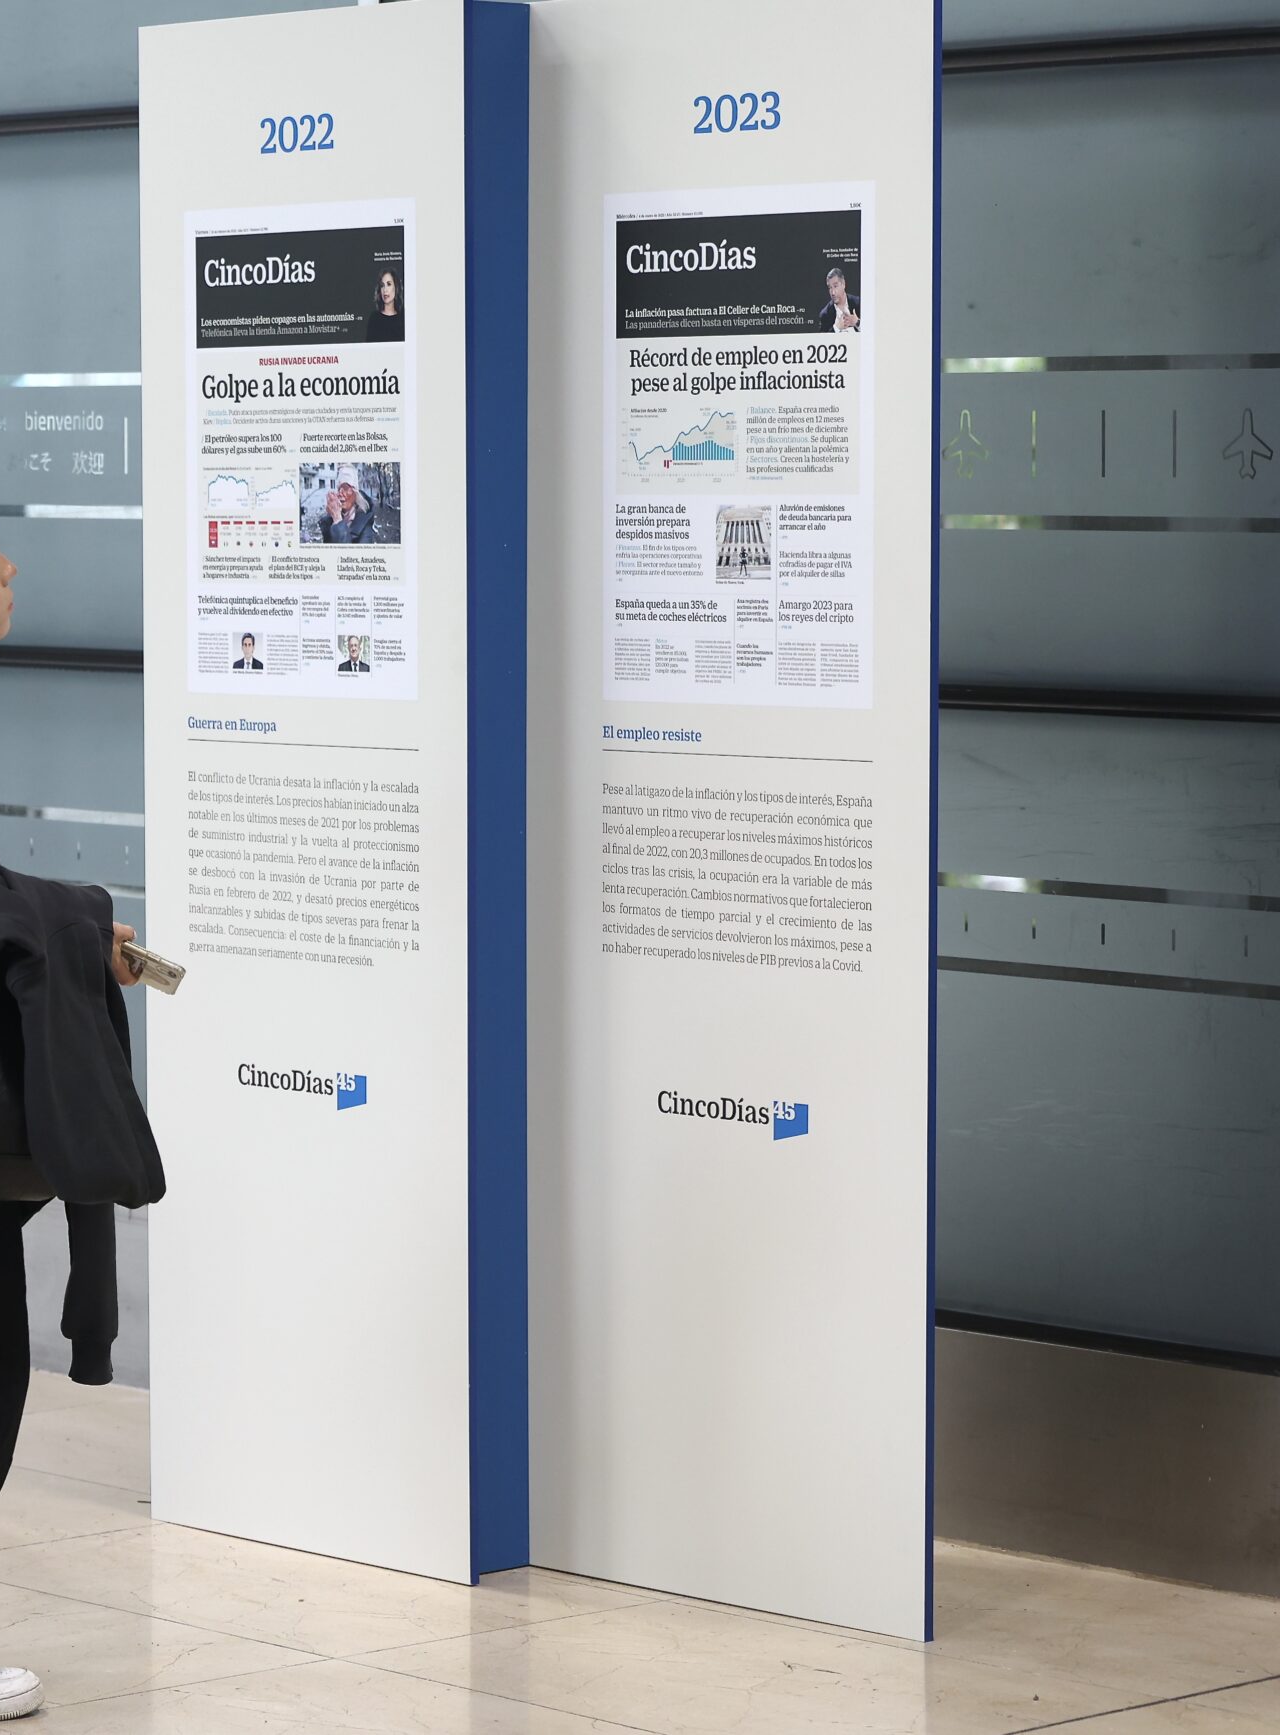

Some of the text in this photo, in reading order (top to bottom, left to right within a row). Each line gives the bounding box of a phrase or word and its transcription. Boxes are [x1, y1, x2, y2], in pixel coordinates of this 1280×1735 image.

[693, 91, 781, 134] 2023
[260, 113, 334, 154] 2022
[625, 239, 757, 274] CincoDías
[204, 253, 316, 288] CincoDías
[200, 311, 356, 326] Los economistas piden copagos en las autonomías
[625, 309, 634, 317] La
[635, 307, 666, 317] inflación
[667, 308, 684, 318] pasa
[685, 305, 712, 316] factura
[718, 305, 726, 315] El
[727, 304, 749, 314] Celler
[749, 304, 760, 314] de
[760, 304, 775, 313] Can
[776, 303, 797, 313] Roca
[625, 320, 637, 329] Las
[638, 318, 679, 330] panaderías
[679, 318, 700, 327] dicen
[701, 317, 721, 327] basta
[732, 316, 764, 327] vísperas
[765, 315, 777, 325] del
[778, 314, 804, 325] roscón
[259, 355, 338, 366] RUSIA INVADE UCRANIA
[629, 343, 846, 367] Récord de empleo en 2022
[202, 368, 400, 403] Golpe a la economía
[631, 369, 845, 396] pese al golpe inflacionista
[25, 410, 104, 432] bienvenido
[72, 450, 104, 475] 欢迎
[615, 503, 686, 515] La gran banca de
[615, 516, 690, 528] inversión prepara
[615, 529, 689, 540] despidos masivos
[615, 598, 717, 610] España queda a un 35% de
[778, 599, 852, 613] Amargo 2023 para
[615, 611, 726, 622] su meta de coches eléctricos
[778, 611, 853, 624] los reyes del cripto
[187, 716, 276, 734] Guerra en Europa
[602, 725, 701, 742] El empleo resiste
[187, 770, 419, 794] El conflicto de Ucrania desata la inflación y la escalada
[602, 804, 872, 830] mantuvo un ritmo vivo de recuperación económica que
[188, 828, 419, 853] de suministro industrial y la vuelta al proteccionismo
[237, 1063, 356, 1096] CincoDías 45
[656, 1090, 796, 1125] CincoDías 45
